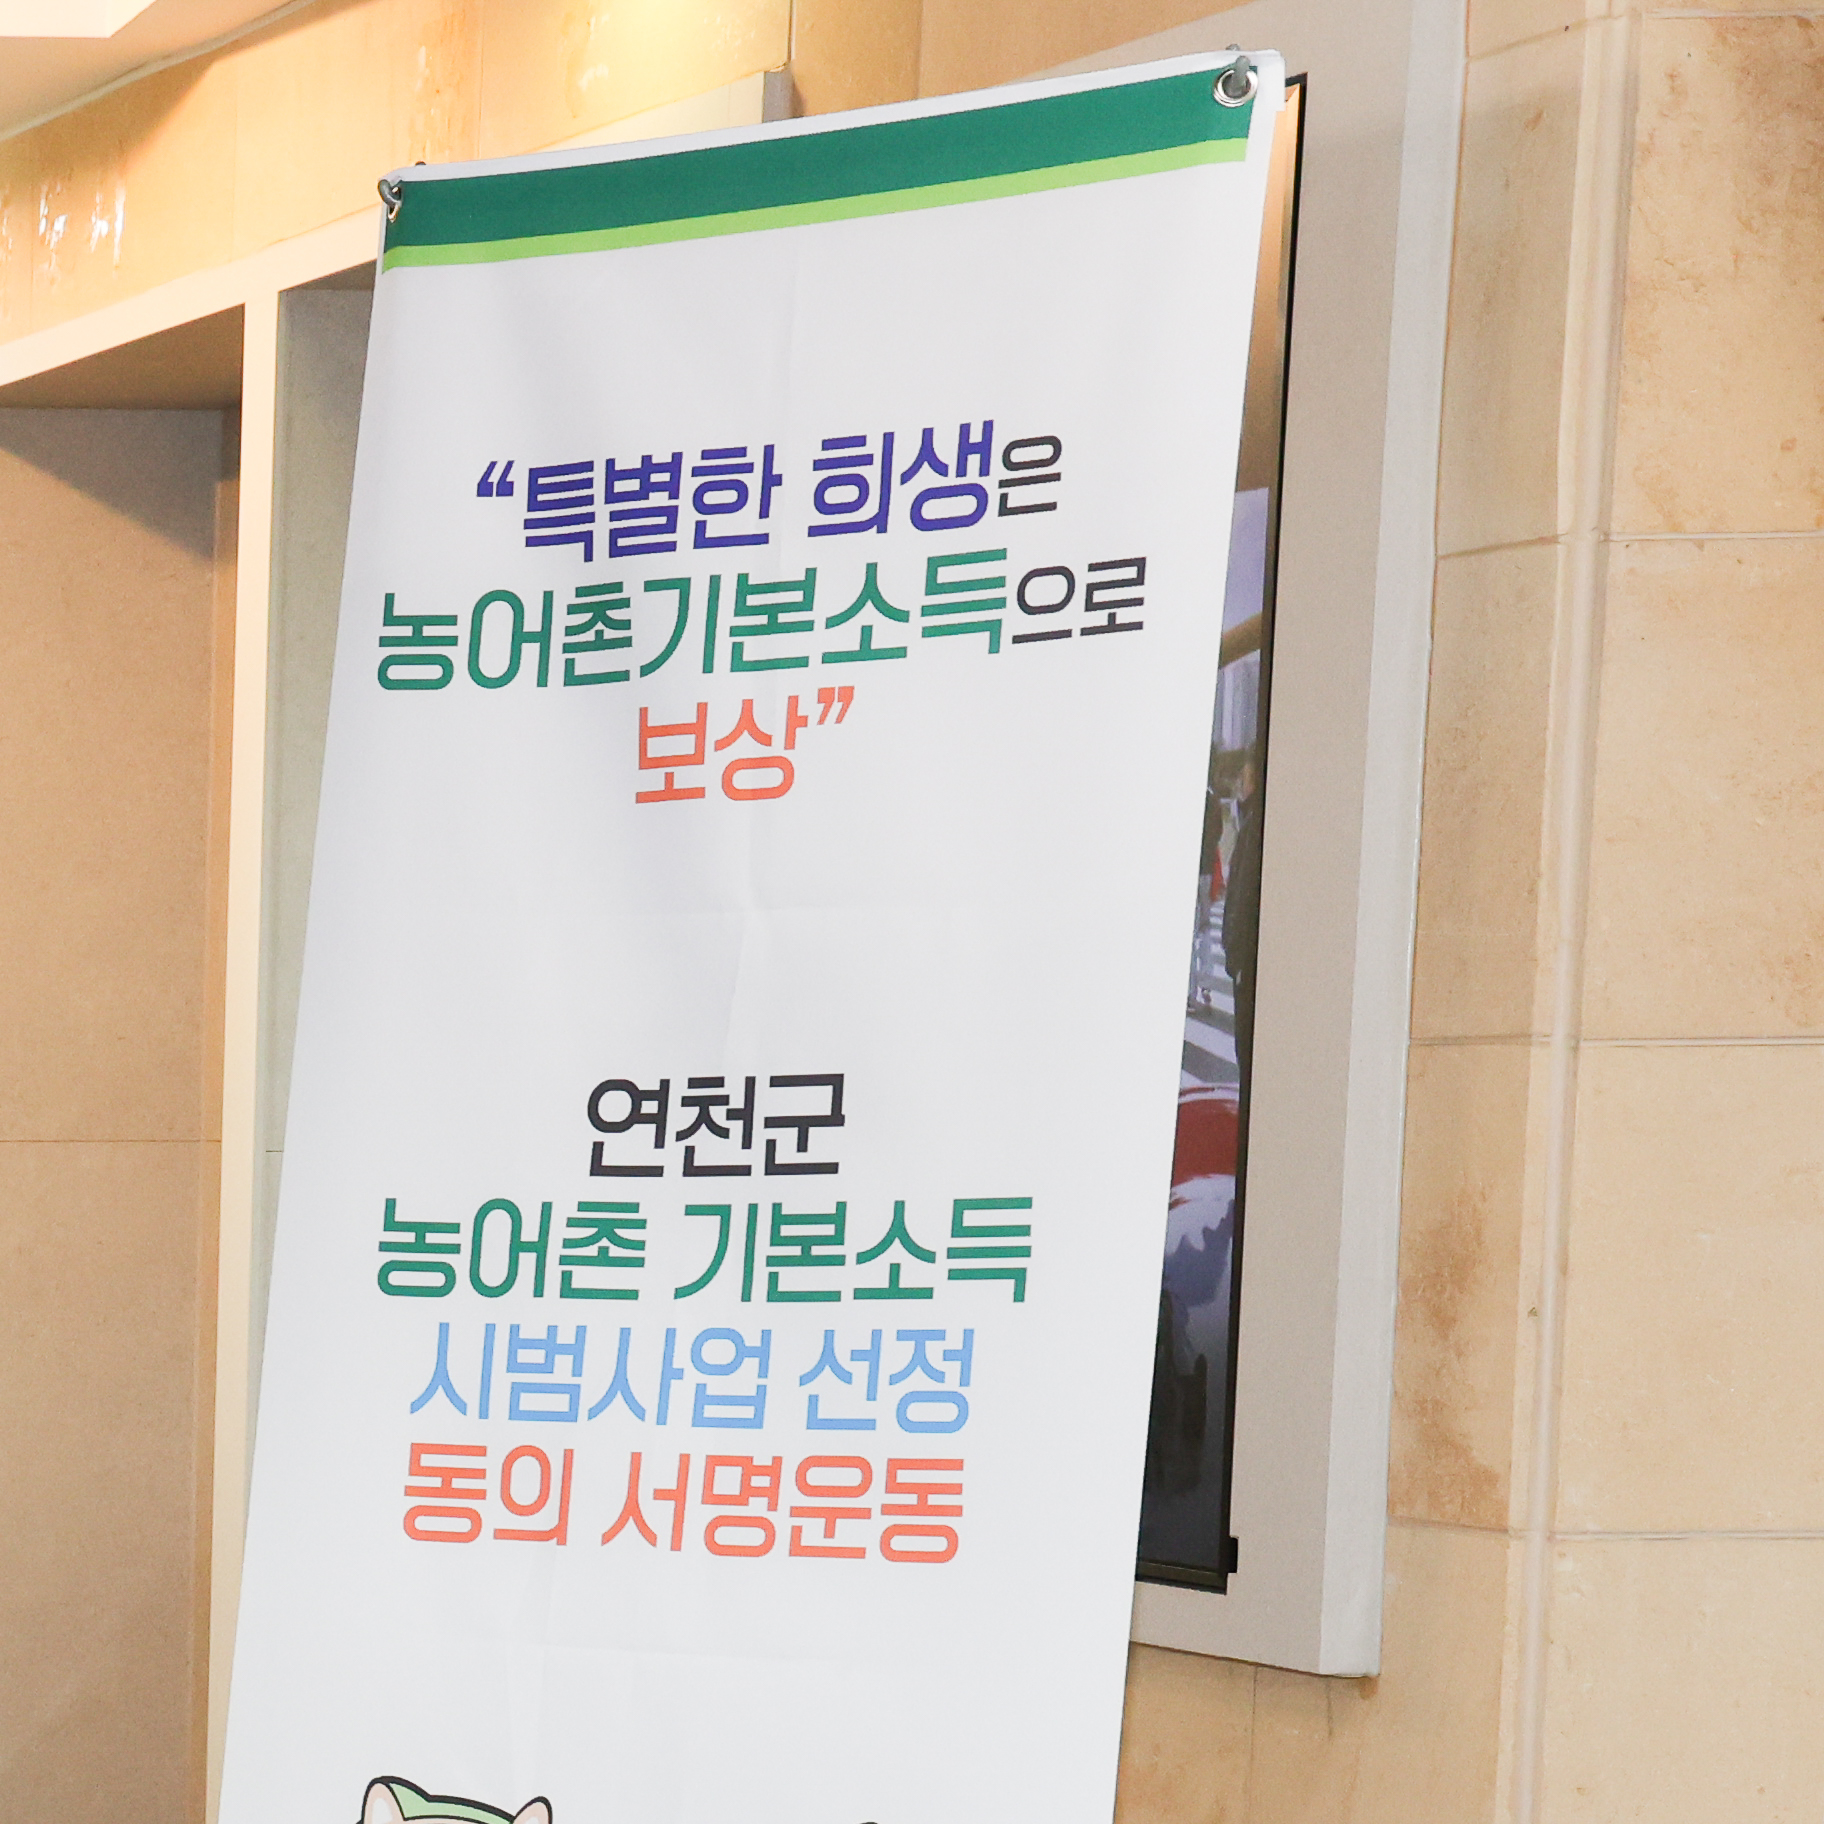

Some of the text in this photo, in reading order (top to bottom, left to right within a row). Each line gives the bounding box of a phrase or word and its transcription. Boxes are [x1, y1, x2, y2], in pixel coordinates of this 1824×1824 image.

[808, 420, 1062, 536] 희생은
[377, 548, 1146, 691] 농어촌기본소득으로
[587, 1074, 844, 1177] 연천군
[378, 1197, 1033, 1303] 농어촌 기본소득
[409, 1322, 974, 1433] 시범사업 선정
[403, 1443, 965, 1563] 동의 서명운동
